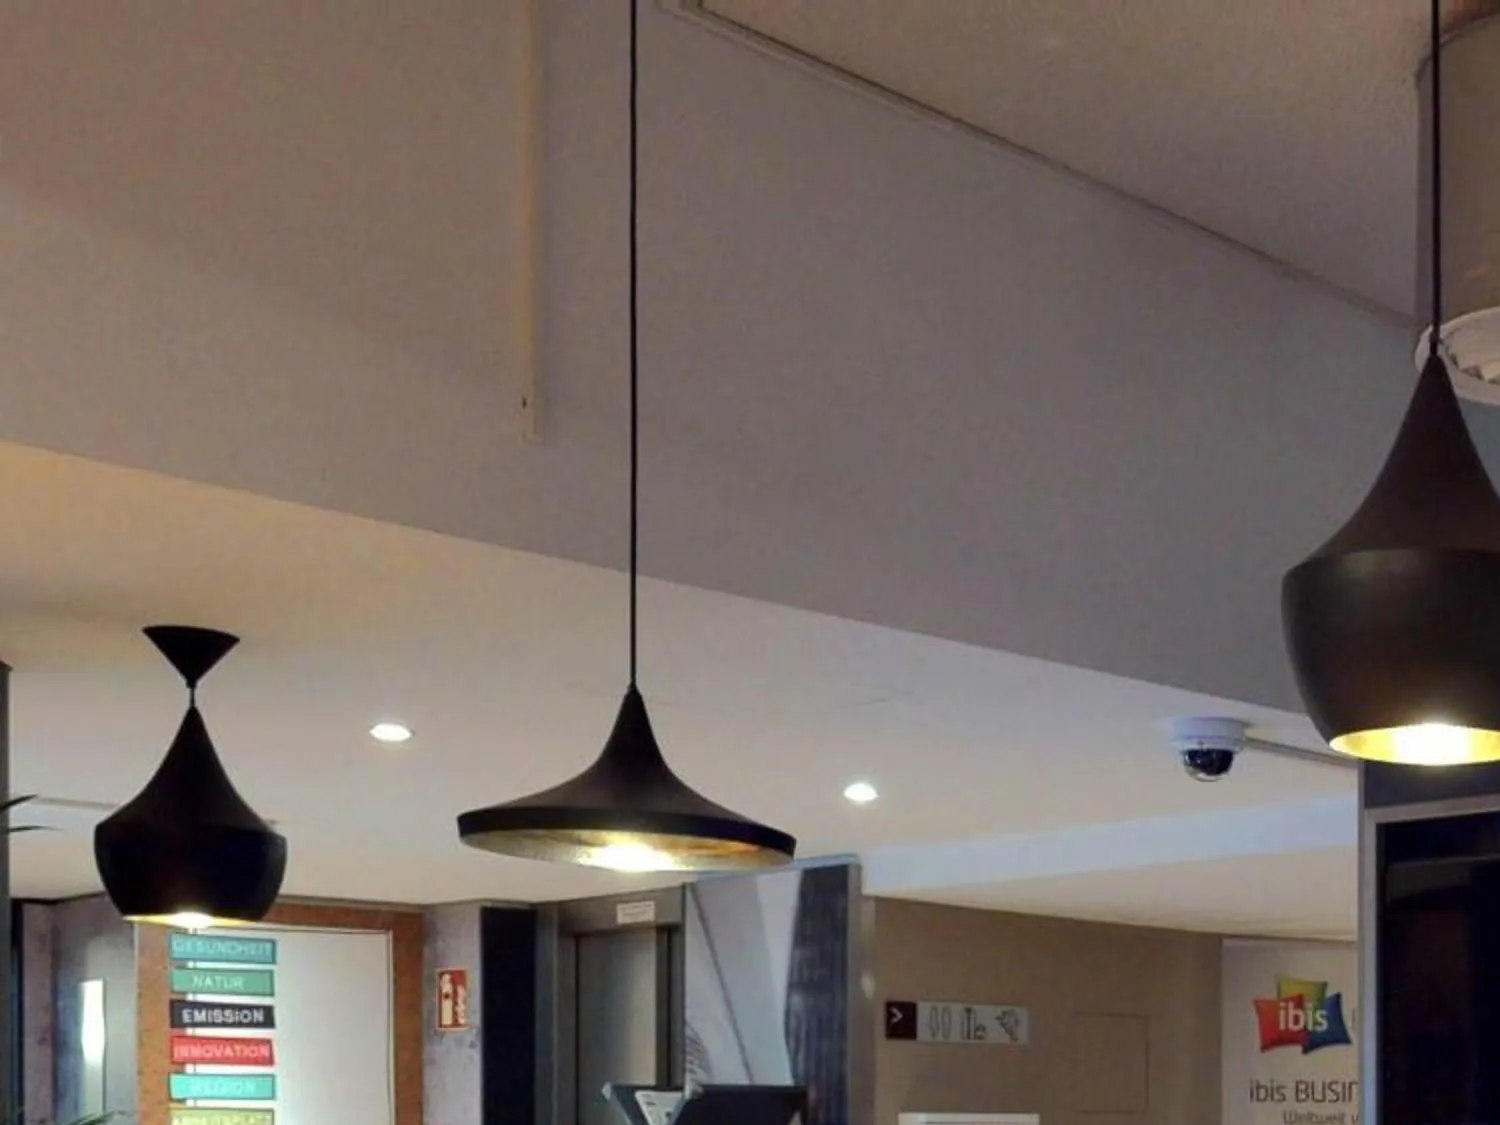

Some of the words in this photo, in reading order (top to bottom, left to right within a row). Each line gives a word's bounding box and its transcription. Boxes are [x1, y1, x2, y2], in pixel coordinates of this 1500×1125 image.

[192, 975, 244, 990] NATUR
[182, 1007, 264, 1024] EMISSION
[1279, 1000, 1328, 1032] ibis
[173, 1043, 270, 1058] INNOVATION
[1250, 1079, 1287, 1103] ibis
